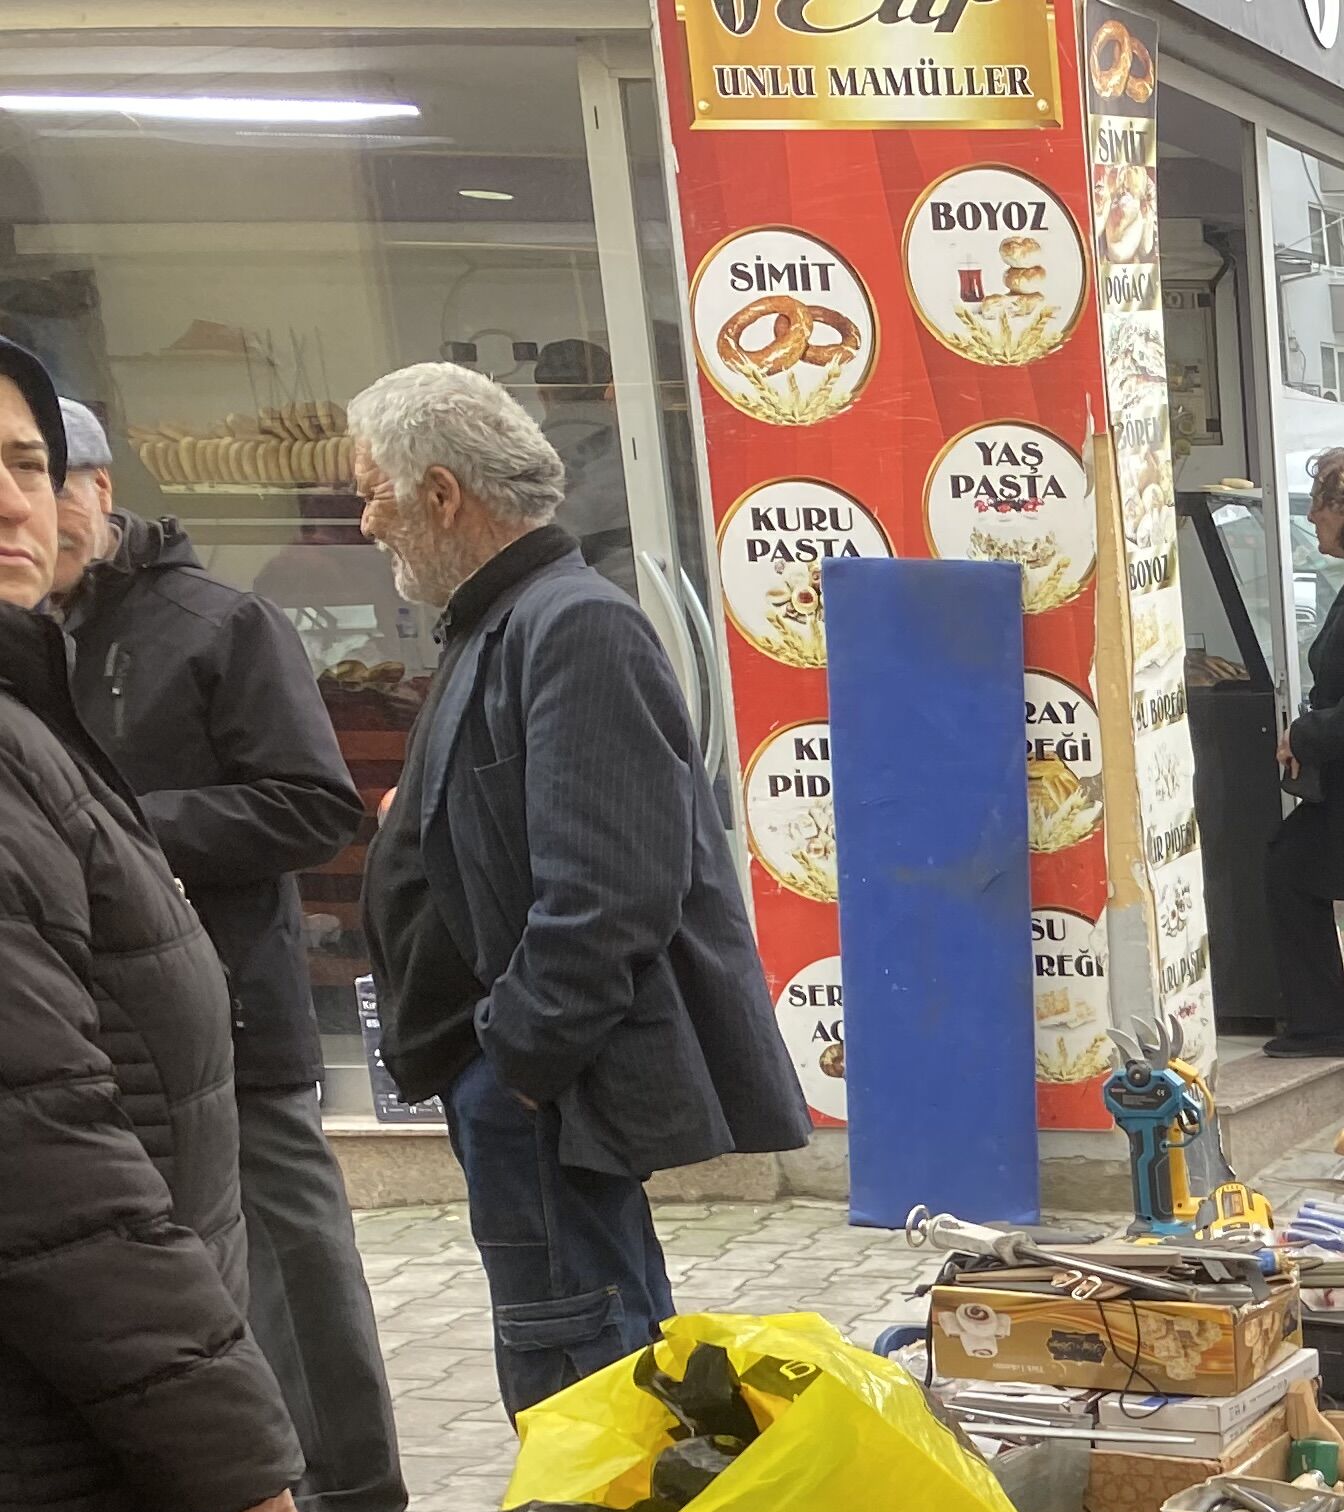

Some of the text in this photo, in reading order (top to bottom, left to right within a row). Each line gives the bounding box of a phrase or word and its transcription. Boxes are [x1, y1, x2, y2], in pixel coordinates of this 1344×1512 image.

[713, 58, 1034, 98] UNLU MAMÜLLER
[1097, 121, 1147, 163] SİMİT
[931, 201, 1049, 232] BOYOZ
[729, 255, 836, 292] SİMİT
[974, 441, 1043, 473] YAŞ
[950, 474, 1067, 501] PASTA
[751, 507, 853, 532] KURU
[747, 538, 861, 563] PASTA
[1128, 553, 1170, 592] BOYOZ
[794, 738, 829, 761] KI
